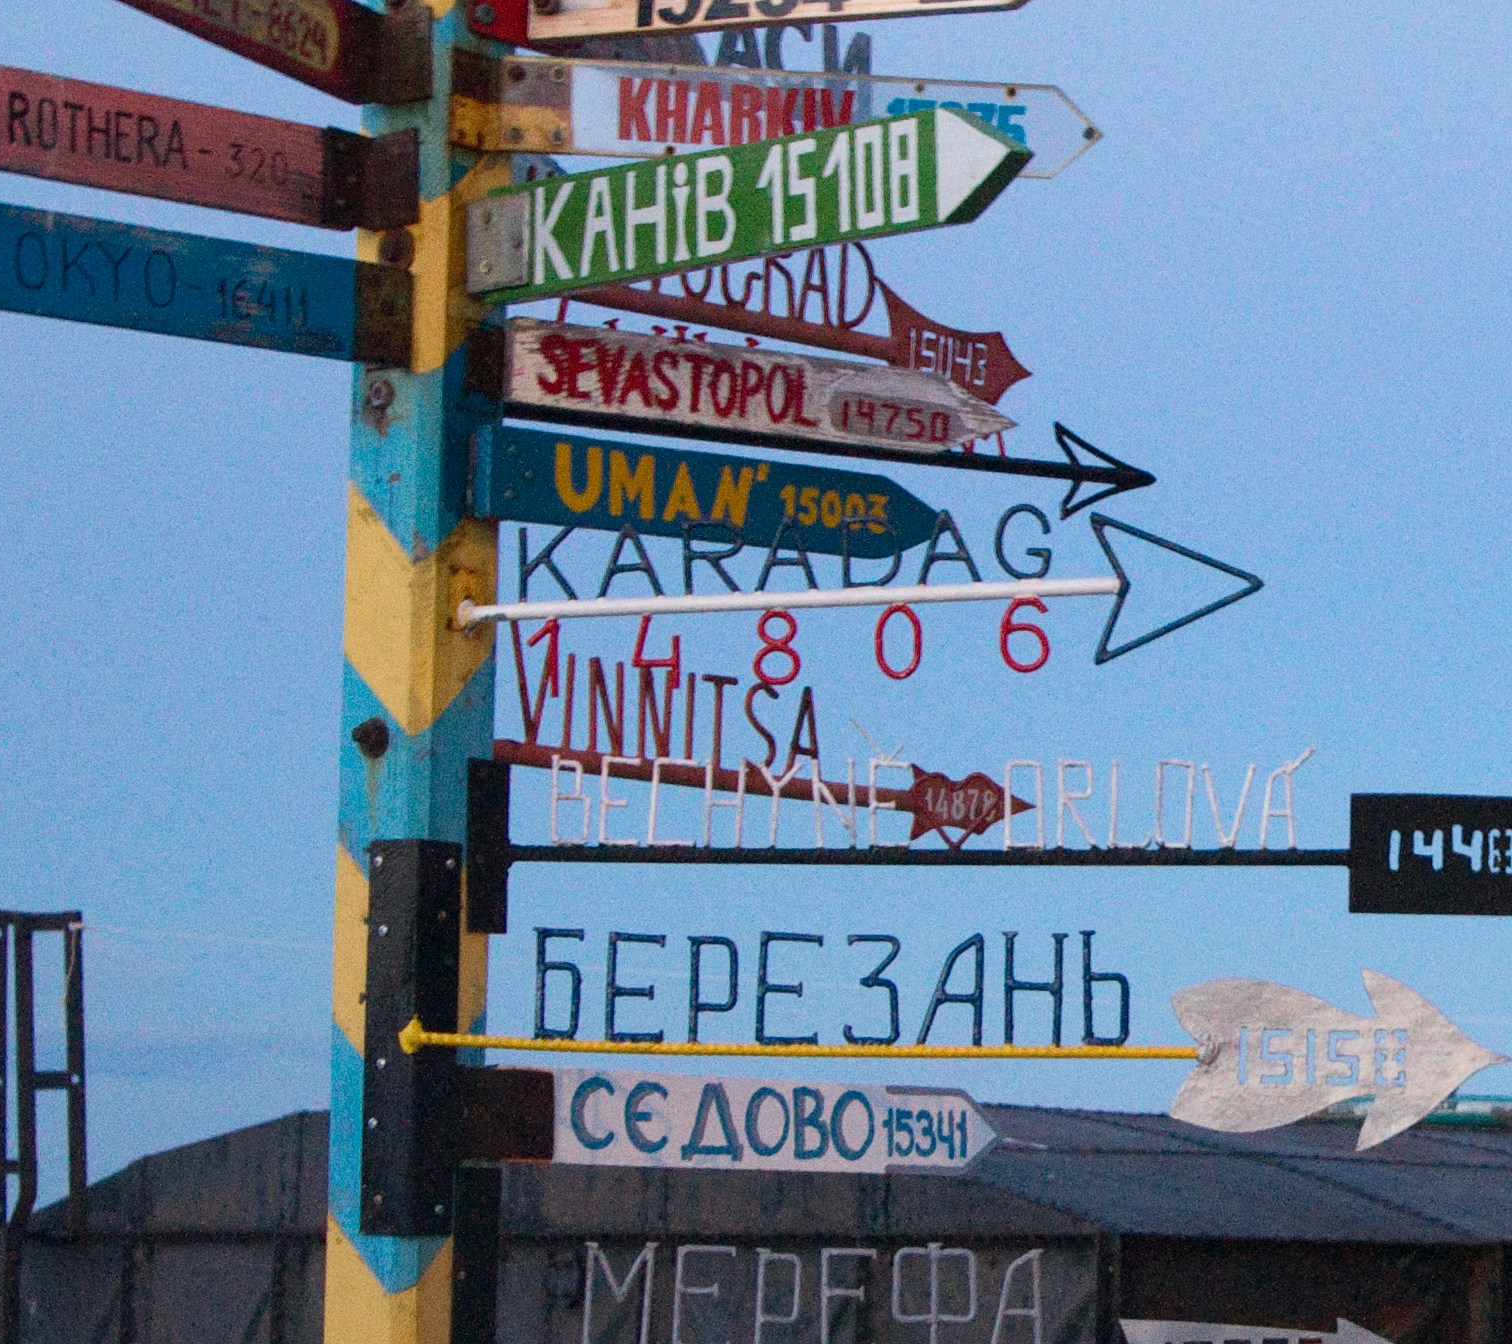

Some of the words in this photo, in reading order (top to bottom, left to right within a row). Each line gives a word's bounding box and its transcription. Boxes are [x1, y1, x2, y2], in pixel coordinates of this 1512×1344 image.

[6, 90, 190, 171] ROTHERA
[618, 77, 856, 146] KHARKIV
[757, 119, 921, 245] 15108
[538, 333, 820, 427] SEVASTOPOL
[842, 398, 951, 443] 14750
[516, 502, 1053, 604] KARADAG
[779, 484, 890, 534] 15003
[509, 621, 823, 776] VINNITSA
[1004, 747, 1315, 850] ORLOVÁ
[531, 925, 1133, 1047] БЕРЕЗАНЬ
[570, 1076, 876, 1162] СЄДОВО
[882, 1107, 968, 1160] 15341
